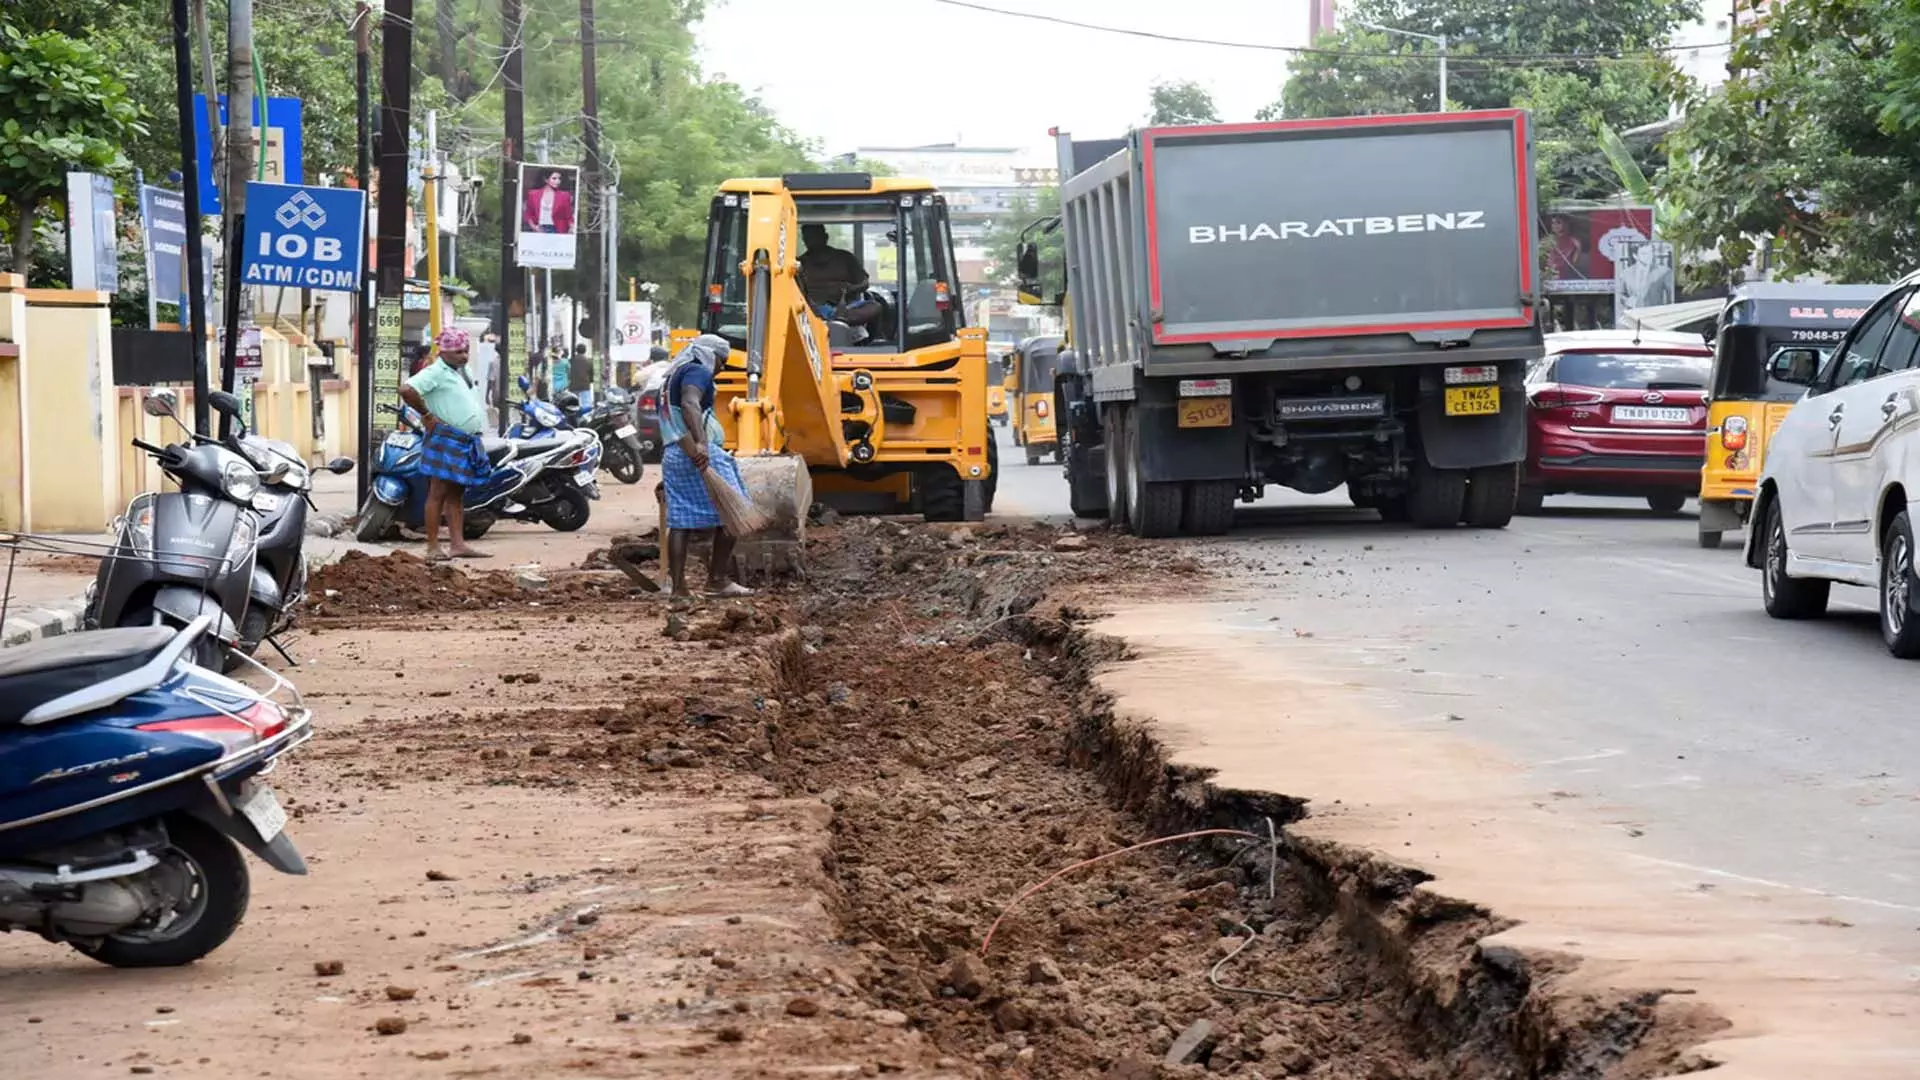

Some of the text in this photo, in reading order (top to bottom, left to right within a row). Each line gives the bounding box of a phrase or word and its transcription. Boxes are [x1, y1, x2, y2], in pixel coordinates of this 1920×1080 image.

[1189, 211, 1485, 243] BHARATBENZ
[259, 232, 342, 261] IOB
[246, 263, 353, 288] ATM/CDM
[1461, 388, 1490, 401] TN45
[1282, 402, 1382, 415] BHARATBENZ
[1453, 400, 1497, 412] CE1345
